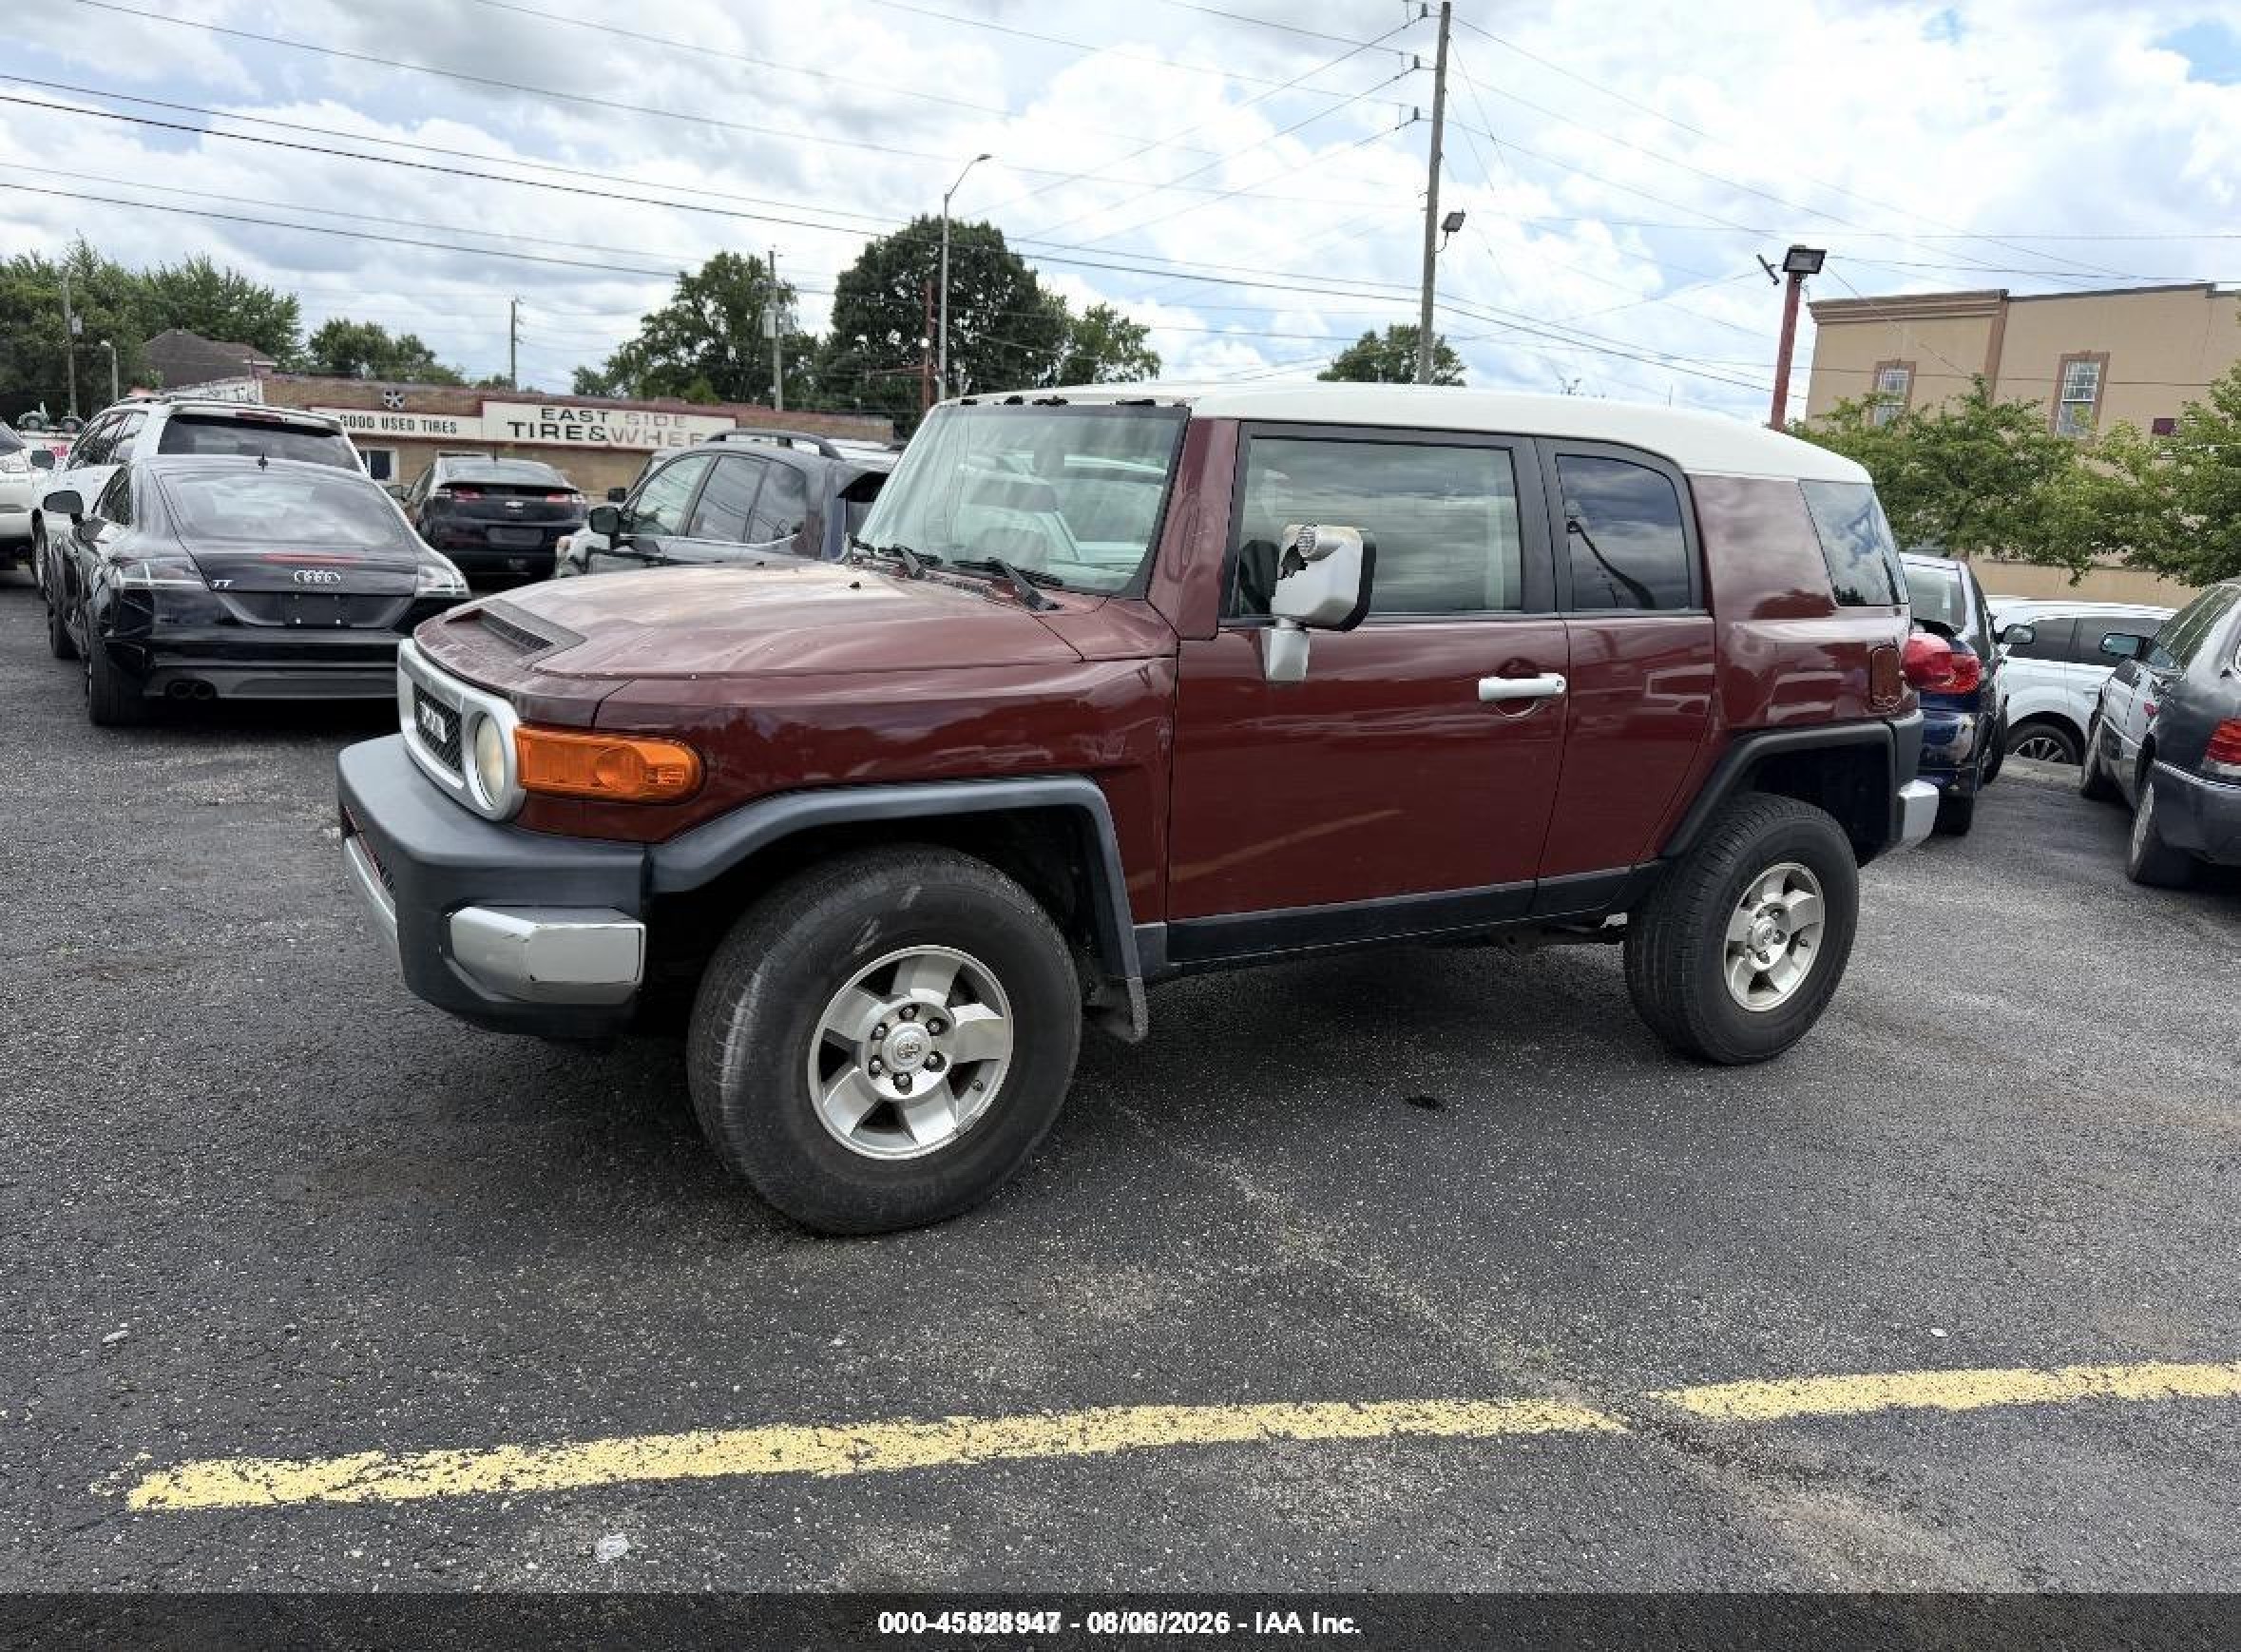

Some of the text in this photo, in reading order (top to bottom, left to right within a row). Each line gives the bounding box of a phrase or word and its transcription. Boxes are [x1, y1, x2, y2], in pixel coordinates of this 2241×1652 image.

[339, 413, 457, 433] GOOD USED TIRES
[541, 408, 687, 428] EAST SIDE
